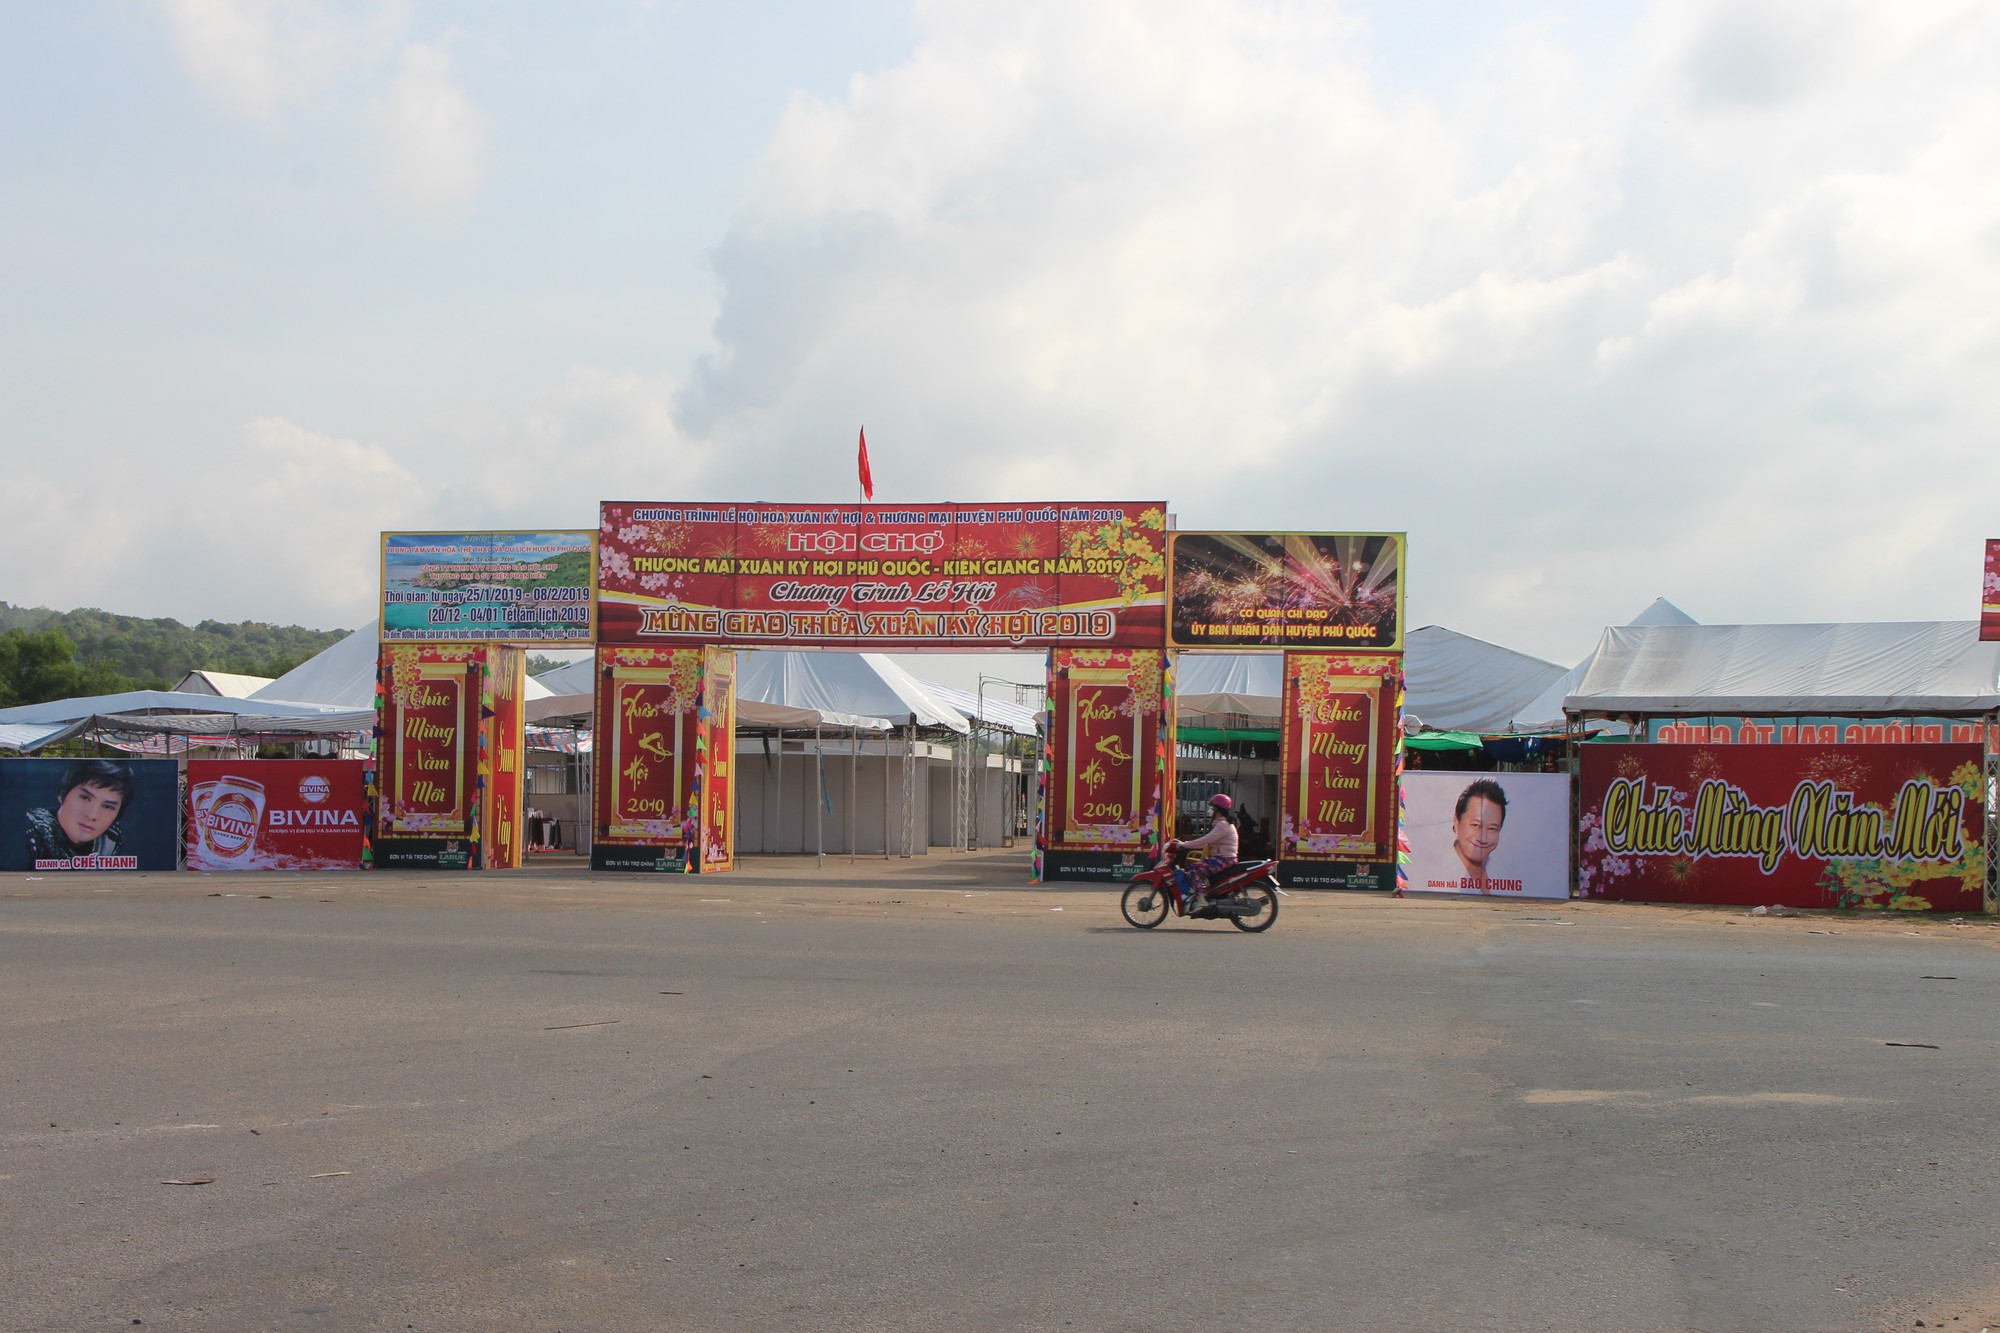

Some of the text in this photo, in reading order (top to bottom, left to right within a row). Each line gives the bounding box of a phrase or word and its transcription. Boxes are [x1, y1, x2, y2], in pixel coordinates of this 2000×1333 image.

[633, 506, 1123, 526] CHƯƠNG TRÌNH LỄ HỘI HOA XUÂN KỶ HỢI & THƯƠNG MẠI HUYỆN PHÚ QUỐC NĂM 2019
[787, 530, 944, 554] HỘI CHỢ
[633, 557, 700, 573] THƯƠNG
[704, 559, 735, 577] MẠI
[739, 559, 784, 575] XUÂN
[788, 558, 809, 575] KỶ
[812, 560, 843, 577] HỢI
[847, 558, 879, 575] PHÚ
[882, 558, 931, 576] QUỐC
[943, 558, 981, 575] KIÊN
[984, 559, 1040, 575] GIANG
[1043, 557, 1084, 574] NĂM
[1086, 560, 1124, 574] 2019
[385, 590, 403, 601] Thời
[406, 592, 429, 603] gian:
[431, 590, 441, 601] từ
[466, 588, 522, 601] 25/1/2019
[534, 588, 590, 601] 08/2/2019
[769, 580, 997, 605] Chương Trình Lễ Hội
[428, 604, 590, 625] (20/12 04/01 Tết âm lịch 2019)
[643, 606, 1112, 641] MỪNG GIAO THỪA XUÂN KỶ HỢI 2019
[1256, 609, 1284, 619] QUAN
[1305, 610, 1329, 620] ĐẠO
[1208, 624, 1229, 635] BAN
[1231, 622, 1260, 635] NHÂN
[1262, 623, 1284, 635] DÂN
[1286, 623, 1320, 639] HUYỆN
[1322, 623, 1343, 637] PHÚ
[1345, 622, 1377, 638] QUỐC
[408, 685, 452, 707] Chúc
[622, 688, 659, 734] Xuân
[1078, 689, 1116, 737] Xuân
[1315, 698, 1363, 722] Chúc
[405, 717, 455, 747] Mừng
[1311, 732, 1367, 764] Mừng
[623, 754, 649, 792] Hợi
[1079, 757, 1106, 796] Hợi
[299, 785, 330, 793] BIVINA
[412, 780, 447, 806] Mới
[269, 809, 359, 825] BIVINA
[627, 798, 665, 816] 2019
[1083, 802, 1122, 822] 2019
[1317, 799, 1356, 826] Mới
[207, 814, 255, 837] BIVINA
[1602, 777, 1963, 873] Chúc Mừng Năm Mới
[36, 853, 136, 869] DANH CA CHẾ THANH
[1427, 880, 1445, 888] DANH
[1446, 879, 1457, 888] HÀI
[1485, 878, 1523, 892] CHUNG
